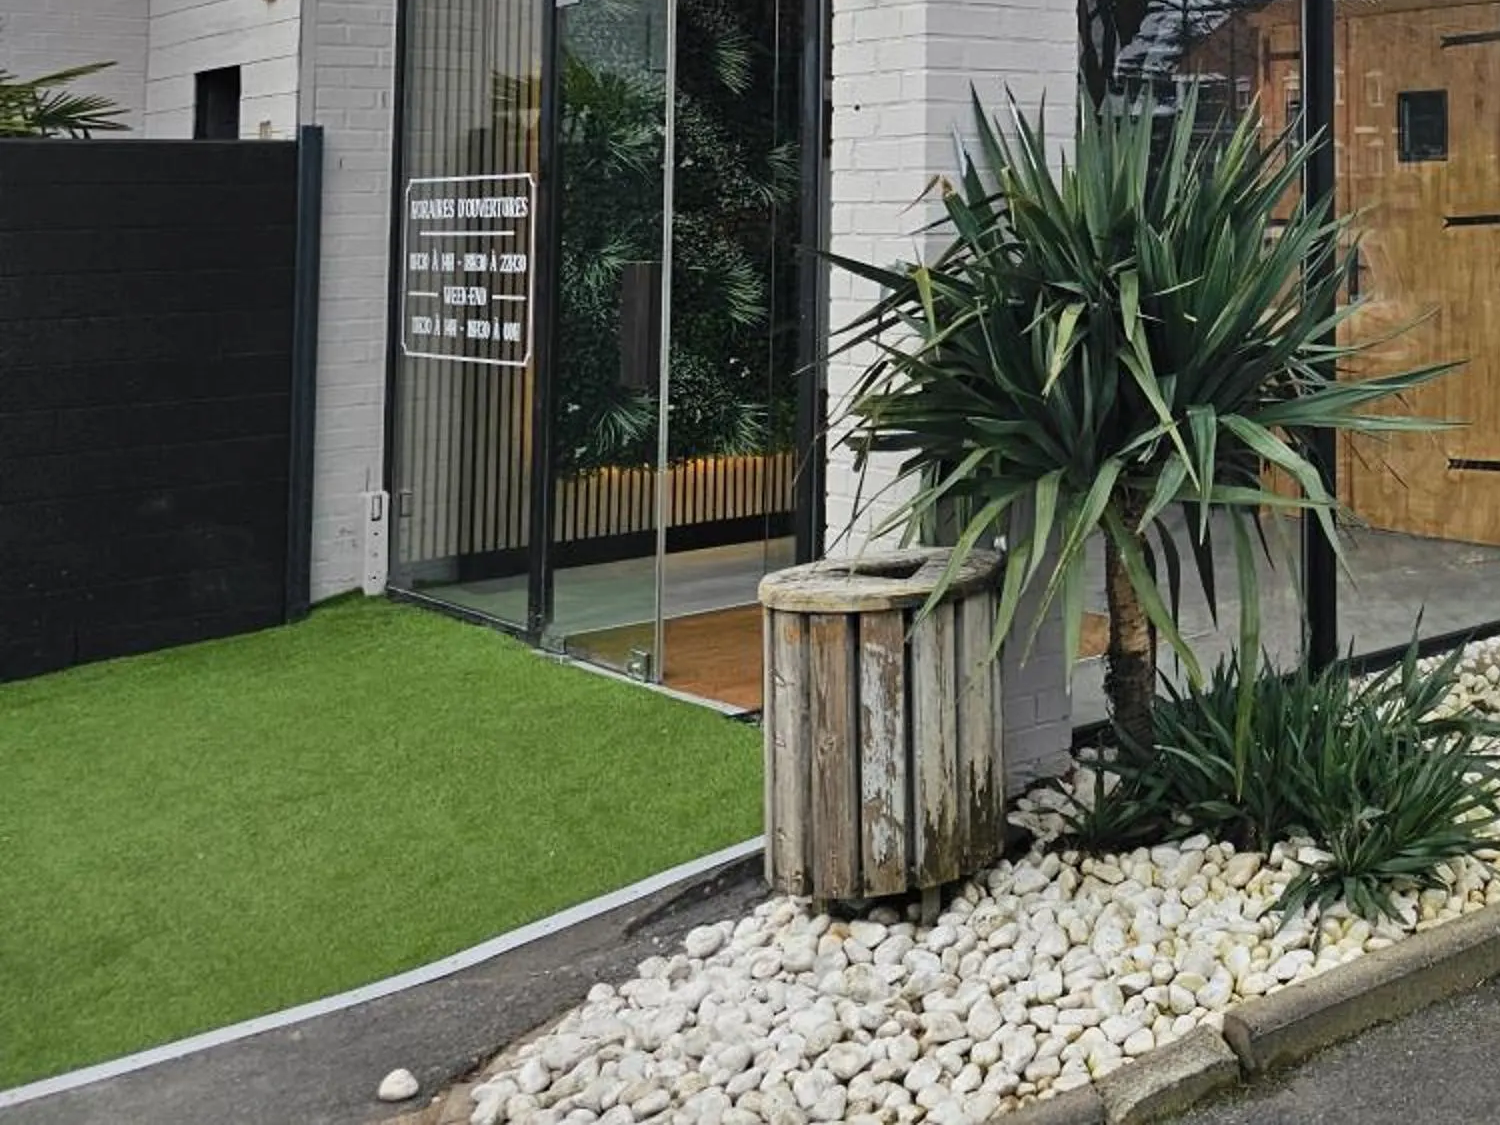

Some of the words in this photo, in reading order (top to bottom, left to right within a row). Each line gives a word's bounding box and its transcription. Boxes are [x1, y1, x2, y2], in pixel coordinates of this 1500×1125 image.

[410, 198, 455, 220] HORAIRES
[457, 196, 529, 218] D'OUVERTURES
[443, 286, 487, 305] WEEK-END
